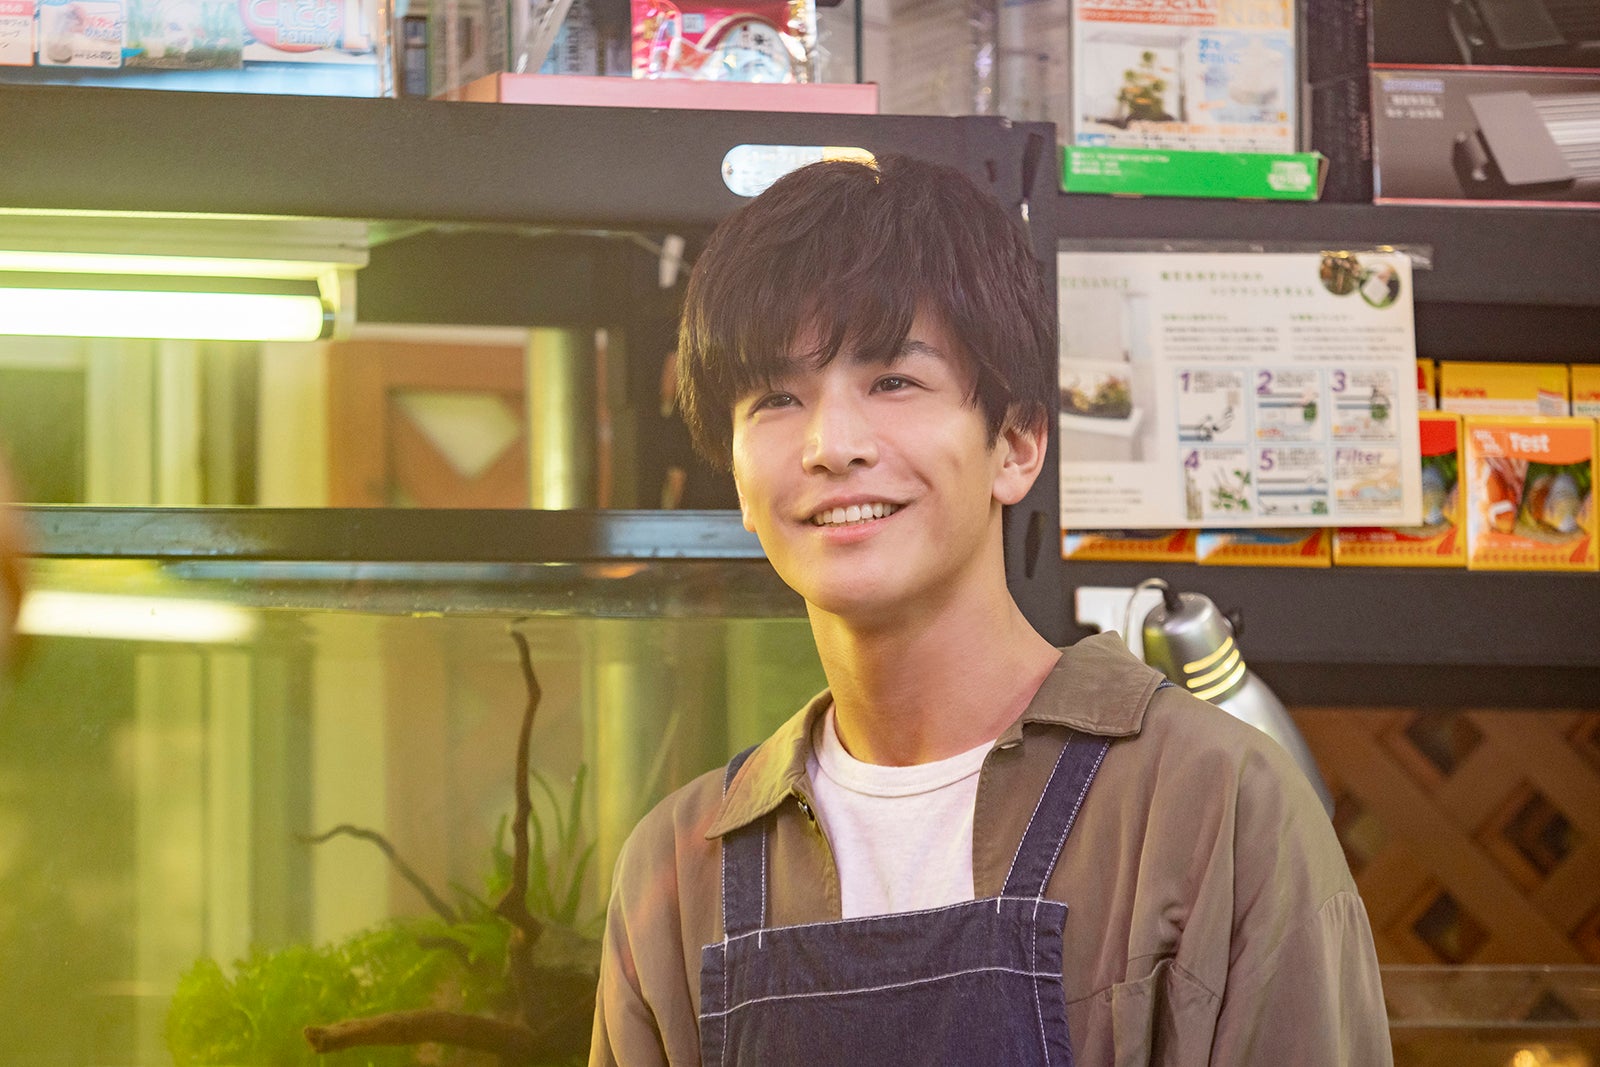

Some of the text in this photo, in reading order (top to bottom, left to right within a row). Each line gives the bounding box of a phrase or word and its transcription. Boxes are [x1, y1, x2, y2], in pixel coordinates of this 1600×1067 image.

[1180, 372, 1190, 392] 1
[1257, 371, 1273, 394] 2
[1332, 370, 1347, 392] 3
[1509, 432, 1550, 453] Test
[1184, 450, 1199, 470] 4
[1259, 449, 1274, 471] 5
[1335, 447, 1383, 467] Filter
